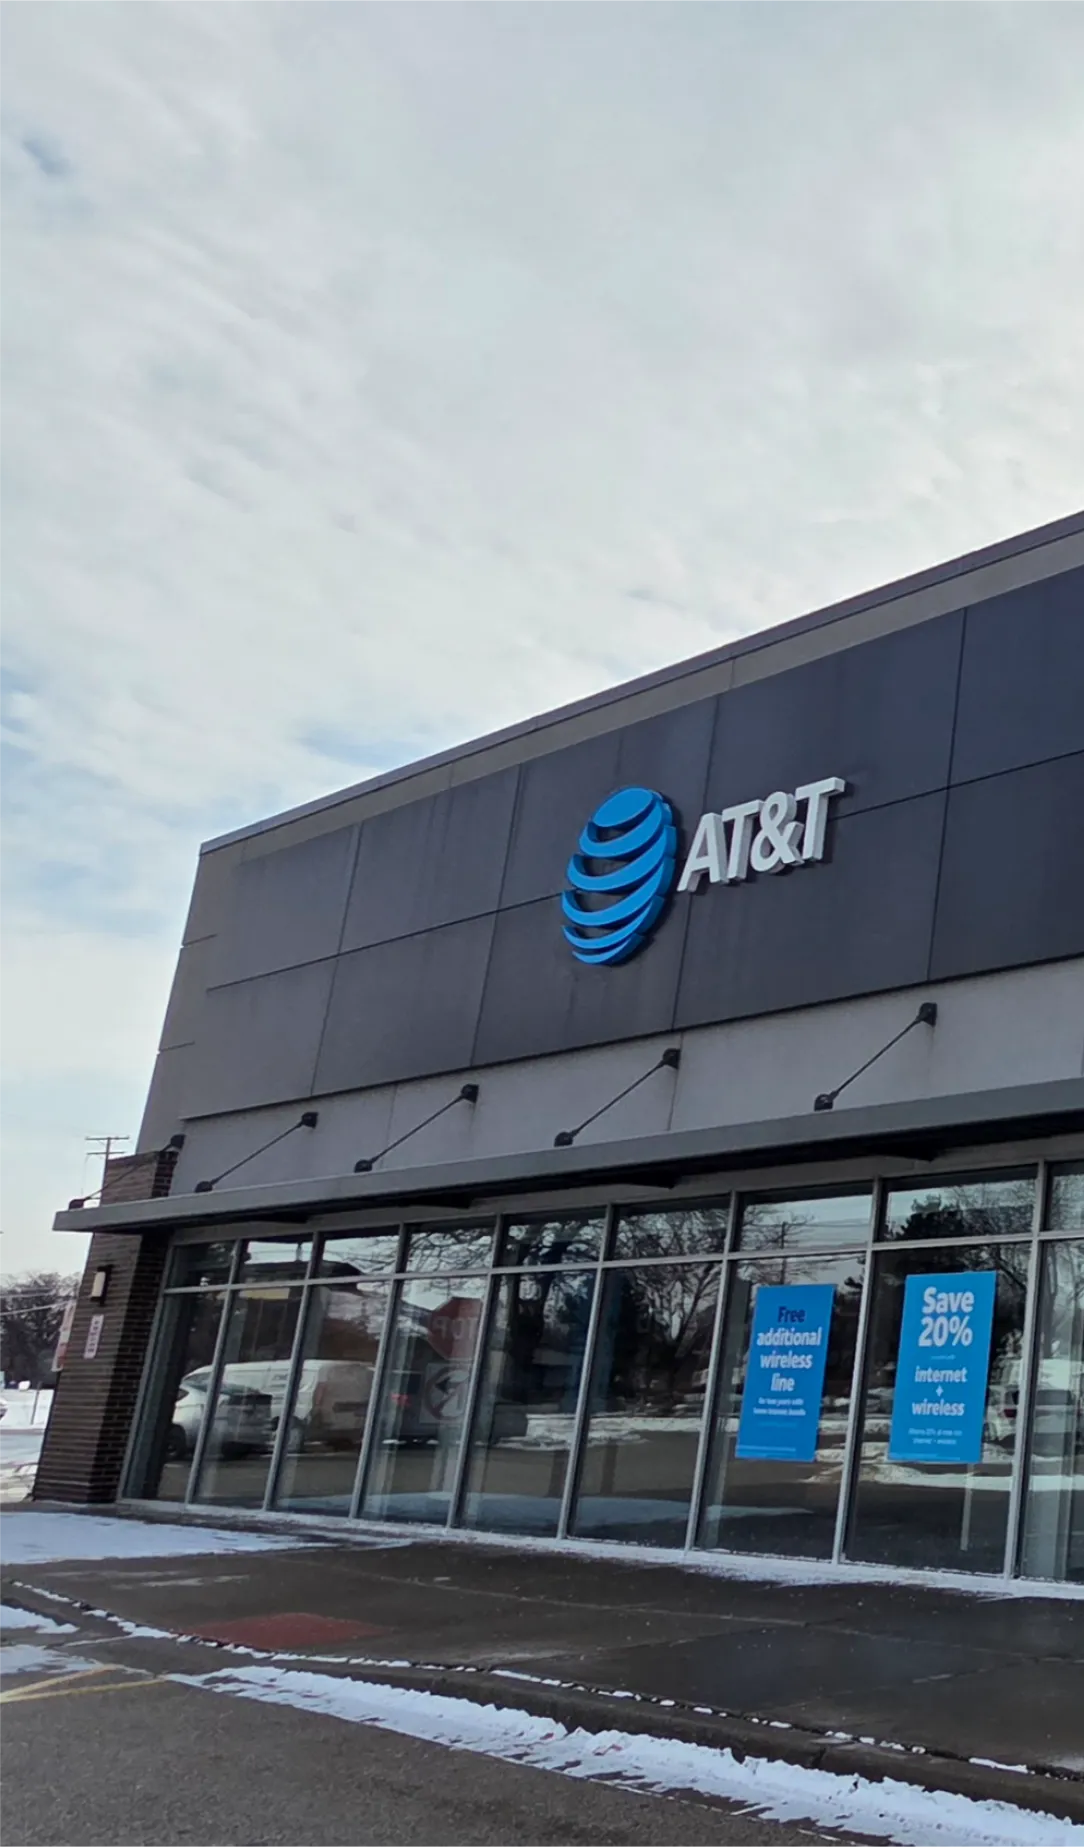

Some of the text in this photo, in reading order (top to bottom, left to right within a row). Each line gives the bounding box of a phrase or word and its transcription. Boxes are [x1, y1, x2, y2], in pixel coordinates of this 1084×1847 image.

[677, 777, 845, 892] AT&T
[922, 1286, 974, 1313] Save
[777, 1306, 806, 1323] Free
[757, 1327, 821, 1346] additional
[918, 1316, 973, 1347] 20%
[760, 1351, 812, 1368] wireless
[771, 1373, 795, 1391] line
[915, 1366, 967, 1382] internet
[912, 1399, 964, 1415] wireless
